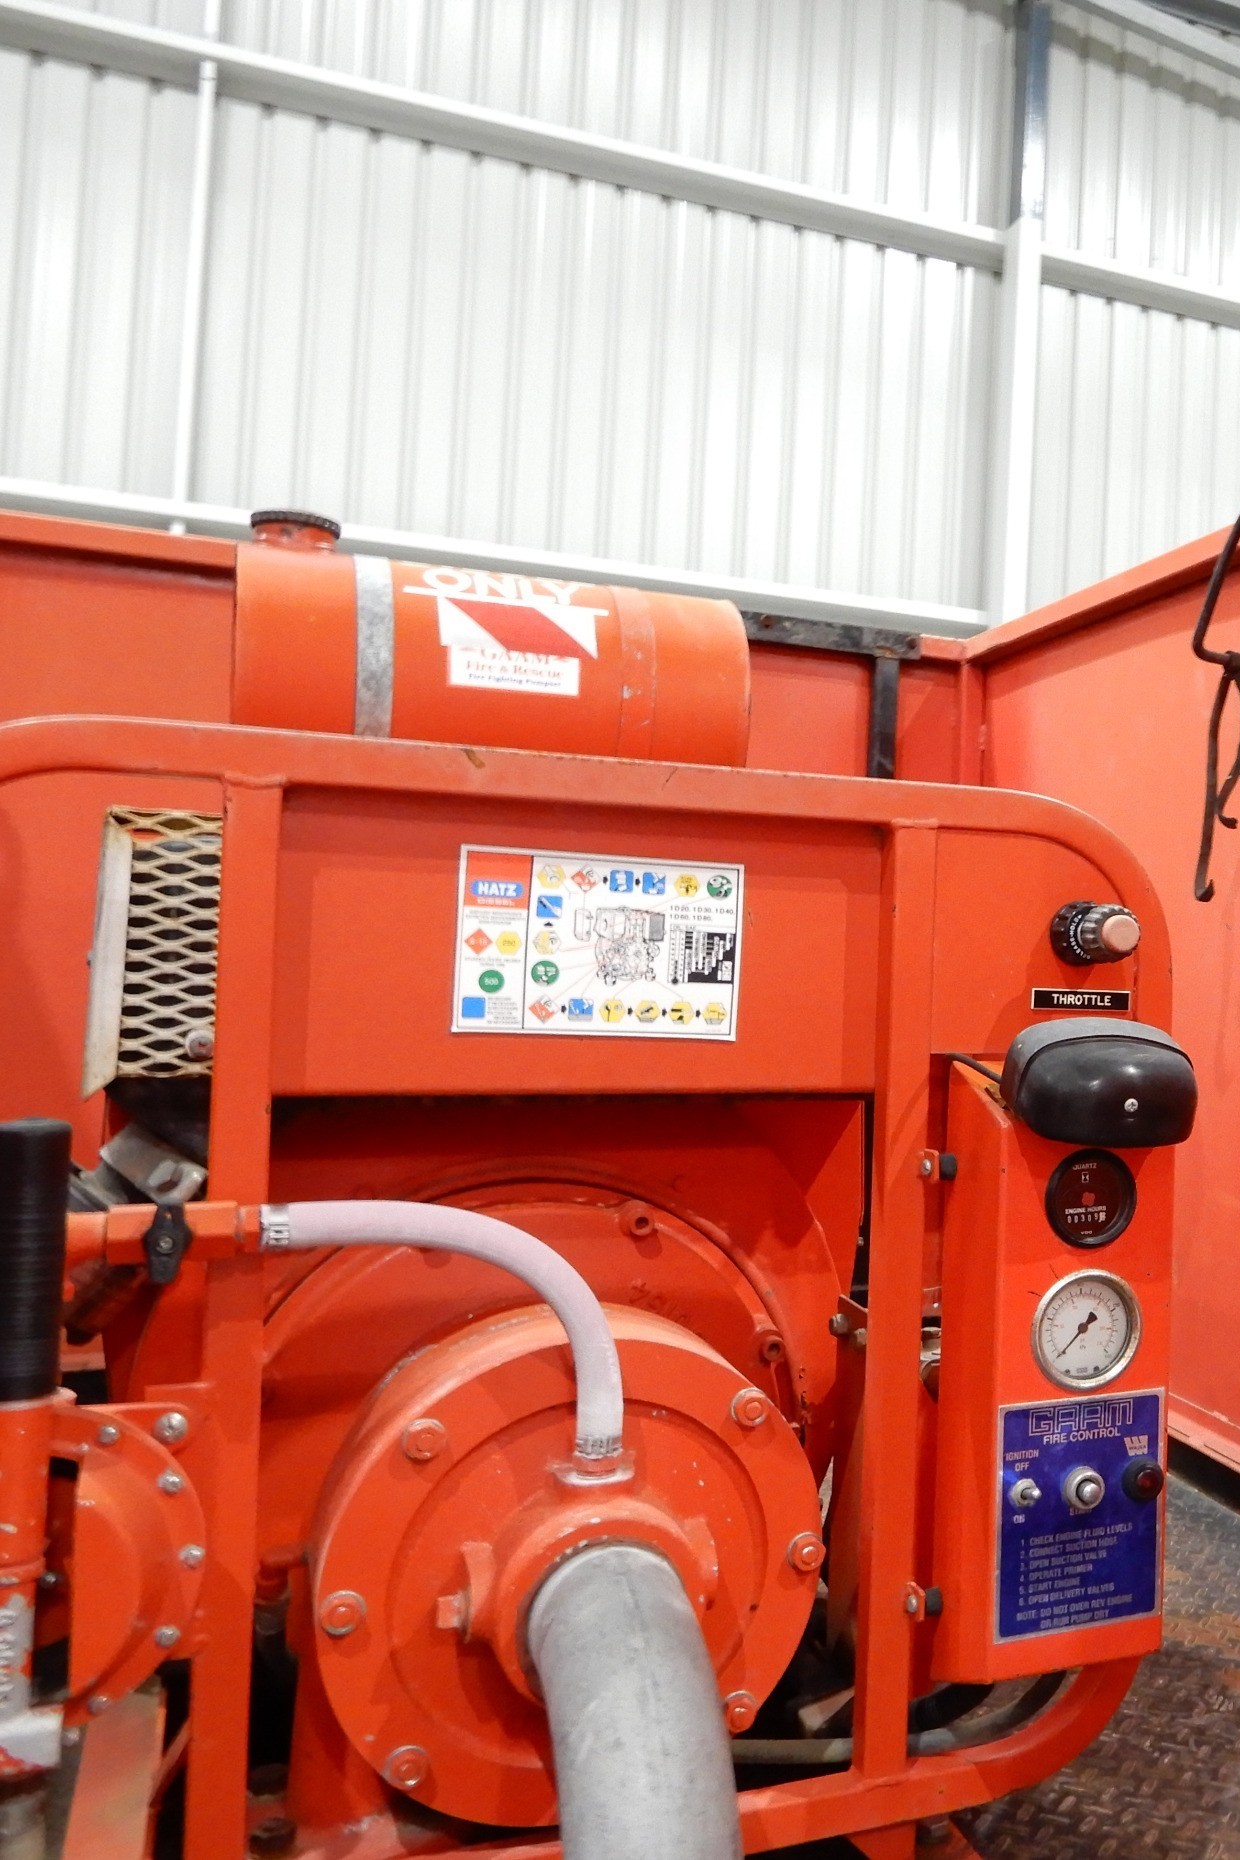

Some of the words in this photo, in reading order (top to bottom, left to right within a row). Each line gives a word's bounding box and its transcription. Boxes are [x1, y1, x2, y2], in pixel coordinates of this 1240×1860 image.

[422, 567, 580, 606] ONLY
[477, 880, 517, 897] HATZ
[1052, 994, 1112, 1006] THROTTLE
[1072, 1162, 1097, 1170] QUARTZ
[1029, 1398, 1133, 1436] GAAM
[1043, 1433, 1068, 1445] FIRE
[1070, 1427, 1121, 1442] CONTROL
[1006, 1449, 1039, 1461] IGNITION
[1014, 1462, 1030, 1472] OFF
[1013, 1514, 1025, 1524] ON
[1030, 1535, 1054, 1546] CHECK
[1055, 1530, 1082, 1542] ENGINE
[1084, 1526, 1106, 1538] FLUID
[1106, 1522, 1133, 1534] LEVELS
[1029, 1544, 1063, 1558] CONNECT
[1066, 1540, 1098, 1552] SUCTION
[1030, 1558, 1050, 1570] OPEN
[1051, 1553, 1083, 1566] SUCTION
[1084, 1549, 1107, 1561] VALVE
[1028, 1568, 1062, 1581] OPERATE
[1064, 1563, 1092, 1575] PRIMER
[1028, 1581, 1052, 1594] START
[1054, 1576, 1080, 1588] ENGINE
[1028, 1594, 1049, 1606] OPEN
[1050, 1588, 1086, 1601] DELIVERY
[1087, 1582, 1115, 1594] VALVES
[1040, 1608, 1052, 1618] DO
[1052, 1604, 1068, 1615] NOT
[1069, 1601, 1090, 1612] OVER
[1090, 1598, 1106, 1608] REV
[1106, 1594, 1133, 1606] ENGINE
[1040, 1619, 1052, 1629] OR
[1052, 1616, 1070, 1626] RUN
[1070, 1612, 1093, 1623] PUMP
[1094, 1609, 1110, 1620] DRY
